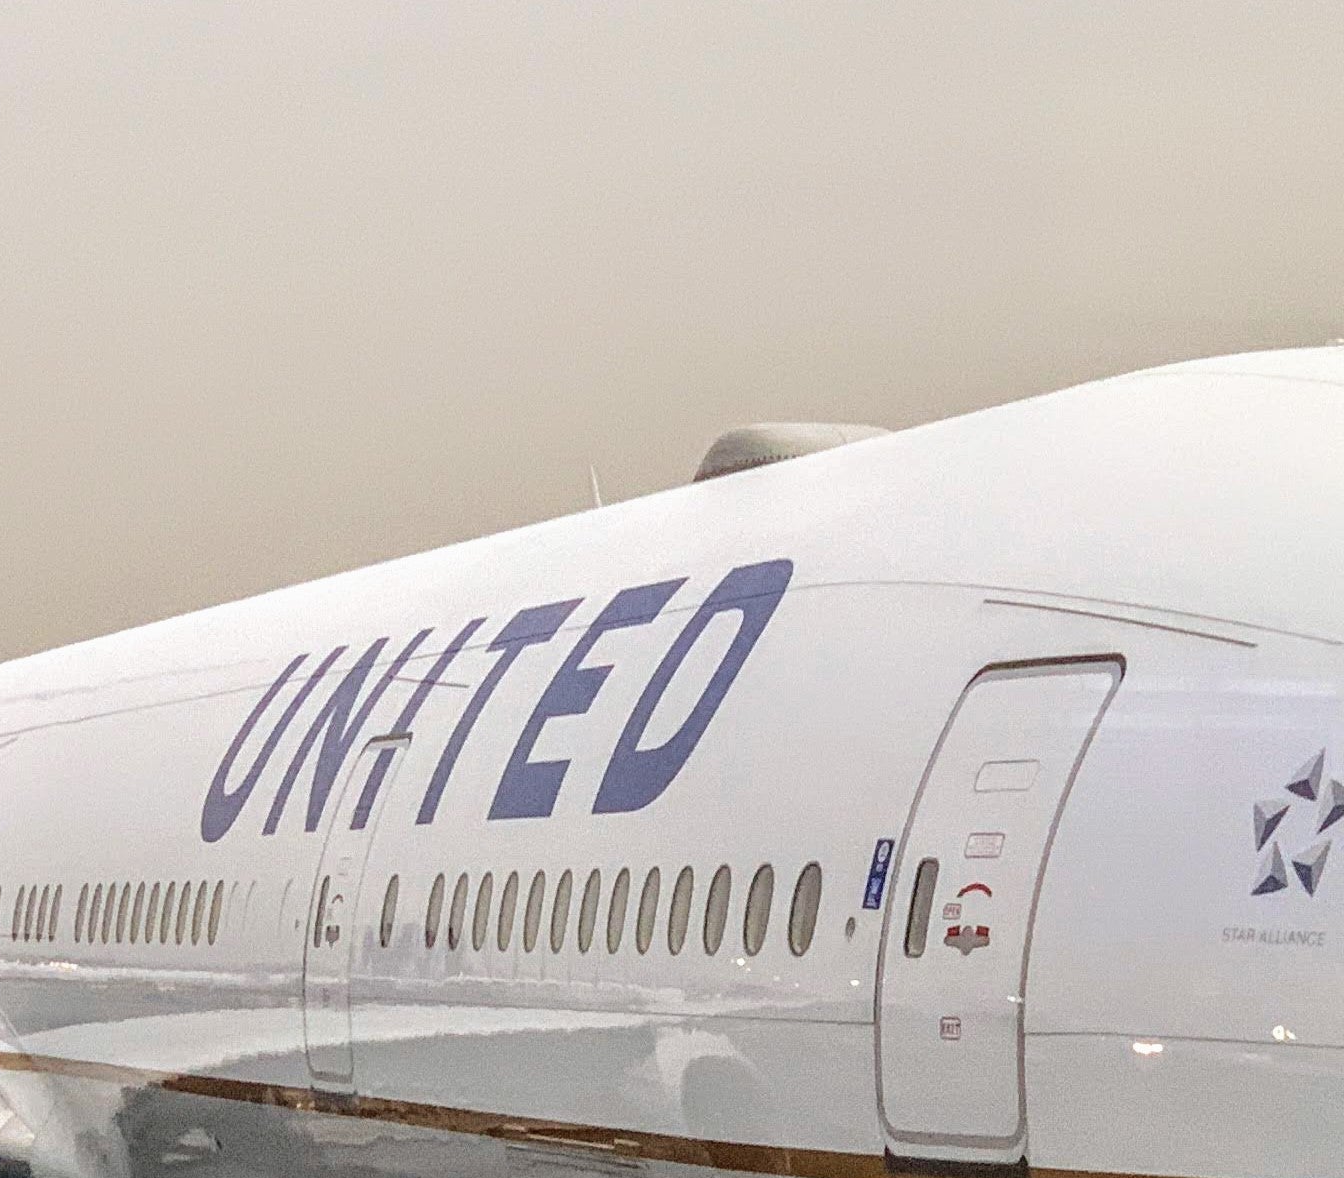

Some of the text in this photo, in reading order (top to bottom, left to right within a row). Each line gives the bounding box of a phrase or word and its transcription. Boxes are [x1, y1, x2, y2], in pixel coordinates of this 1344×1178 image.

[201, 559, 794, 843] UNITED
[1222, 926, 1326, 947] STAR ALLIANCE
